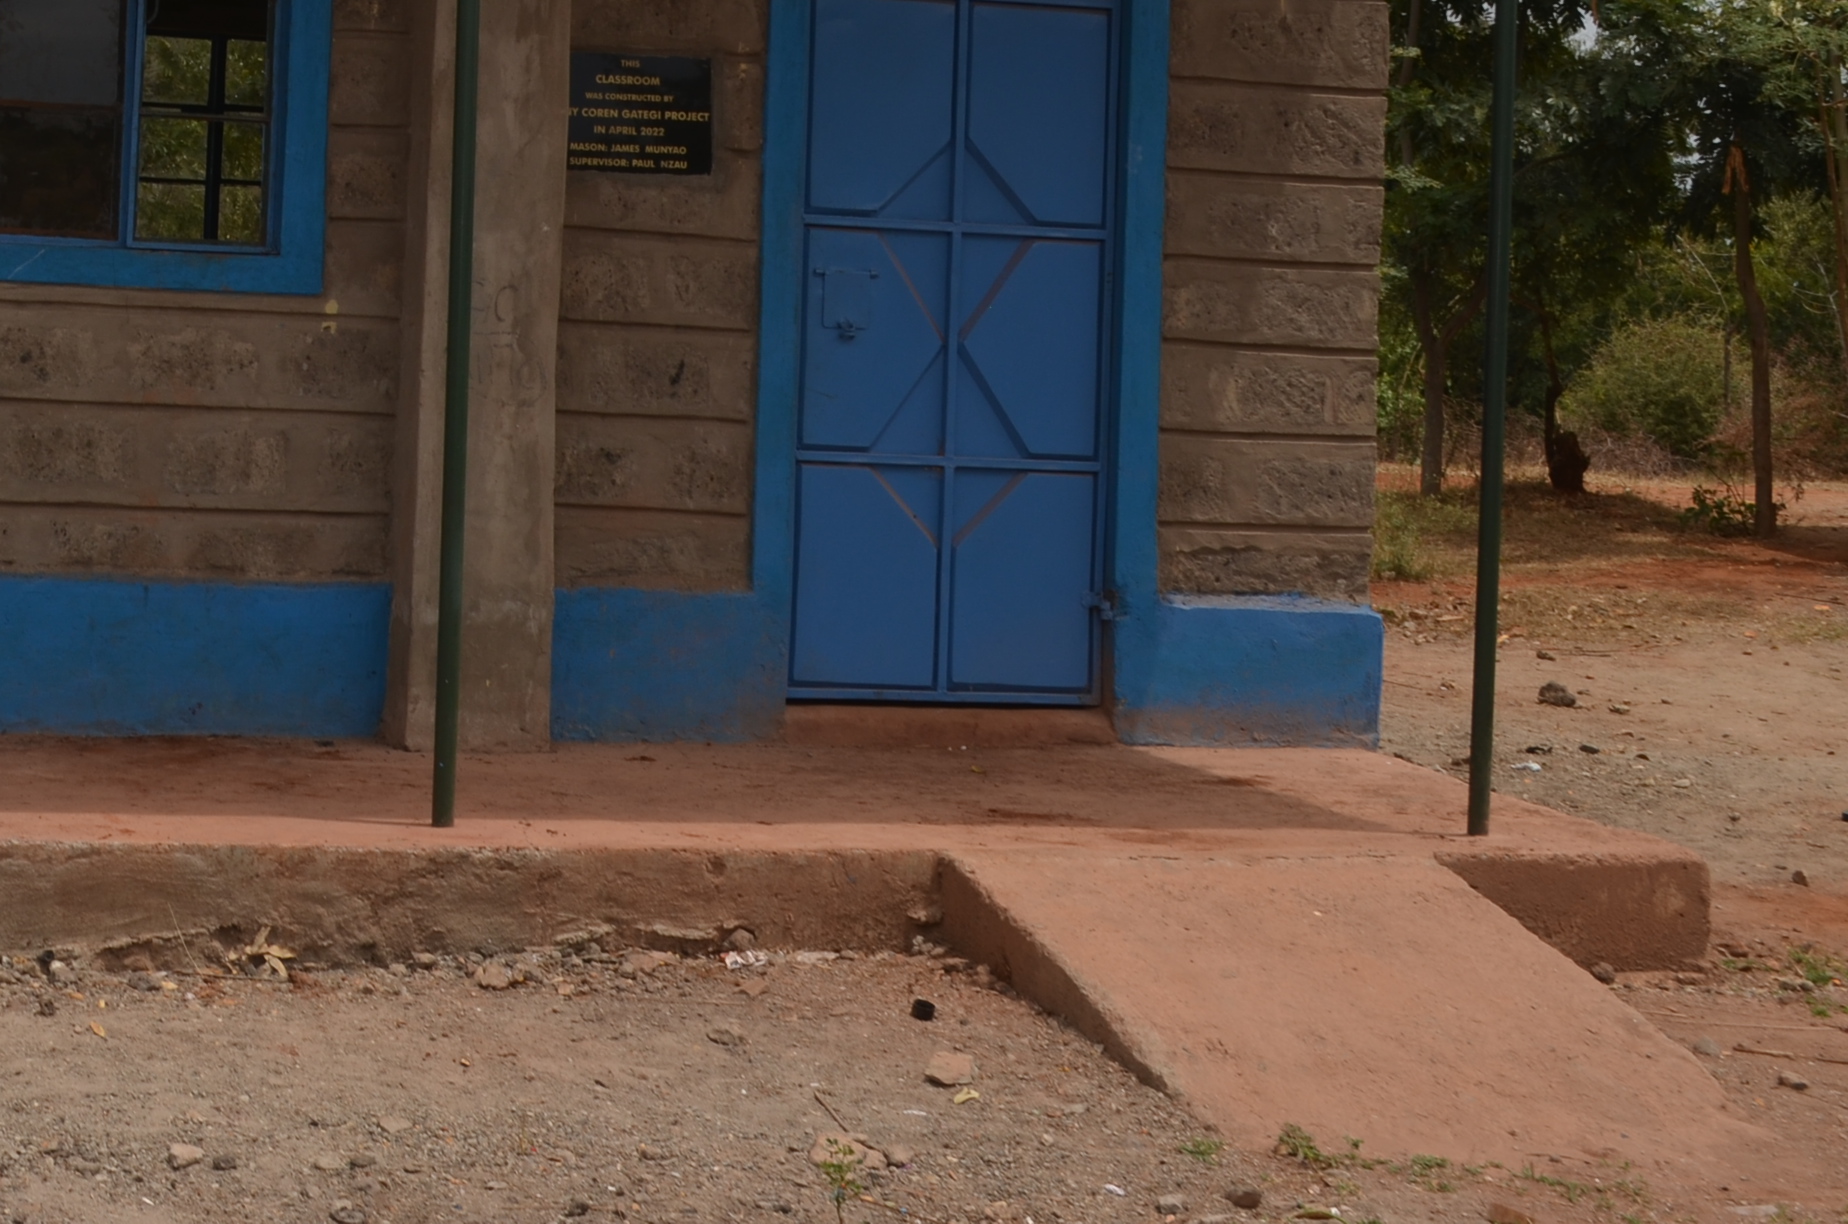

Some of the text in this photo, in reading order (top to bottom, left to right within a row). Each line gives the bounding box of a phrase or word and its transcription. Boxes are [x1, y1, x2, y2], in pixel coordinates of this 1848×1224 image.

[621, 59, 640, 68] THIS
[596, 75, 660, 85] CLASSROOM
[605, 93, 661, 102] CONSTRUCTED
[582, 108, 618, 118] COREN
[622, 109, 661, 119] GATEGI
[664, 111, 710, 121] PROJECT
[594, 126, 664, 136] IN APRIL 2022
[570, 143, 686, 154] MASON: JAMES MUNYAO
[570, 157, 687, 169] SUPERVISOR: PAUL NZAU
